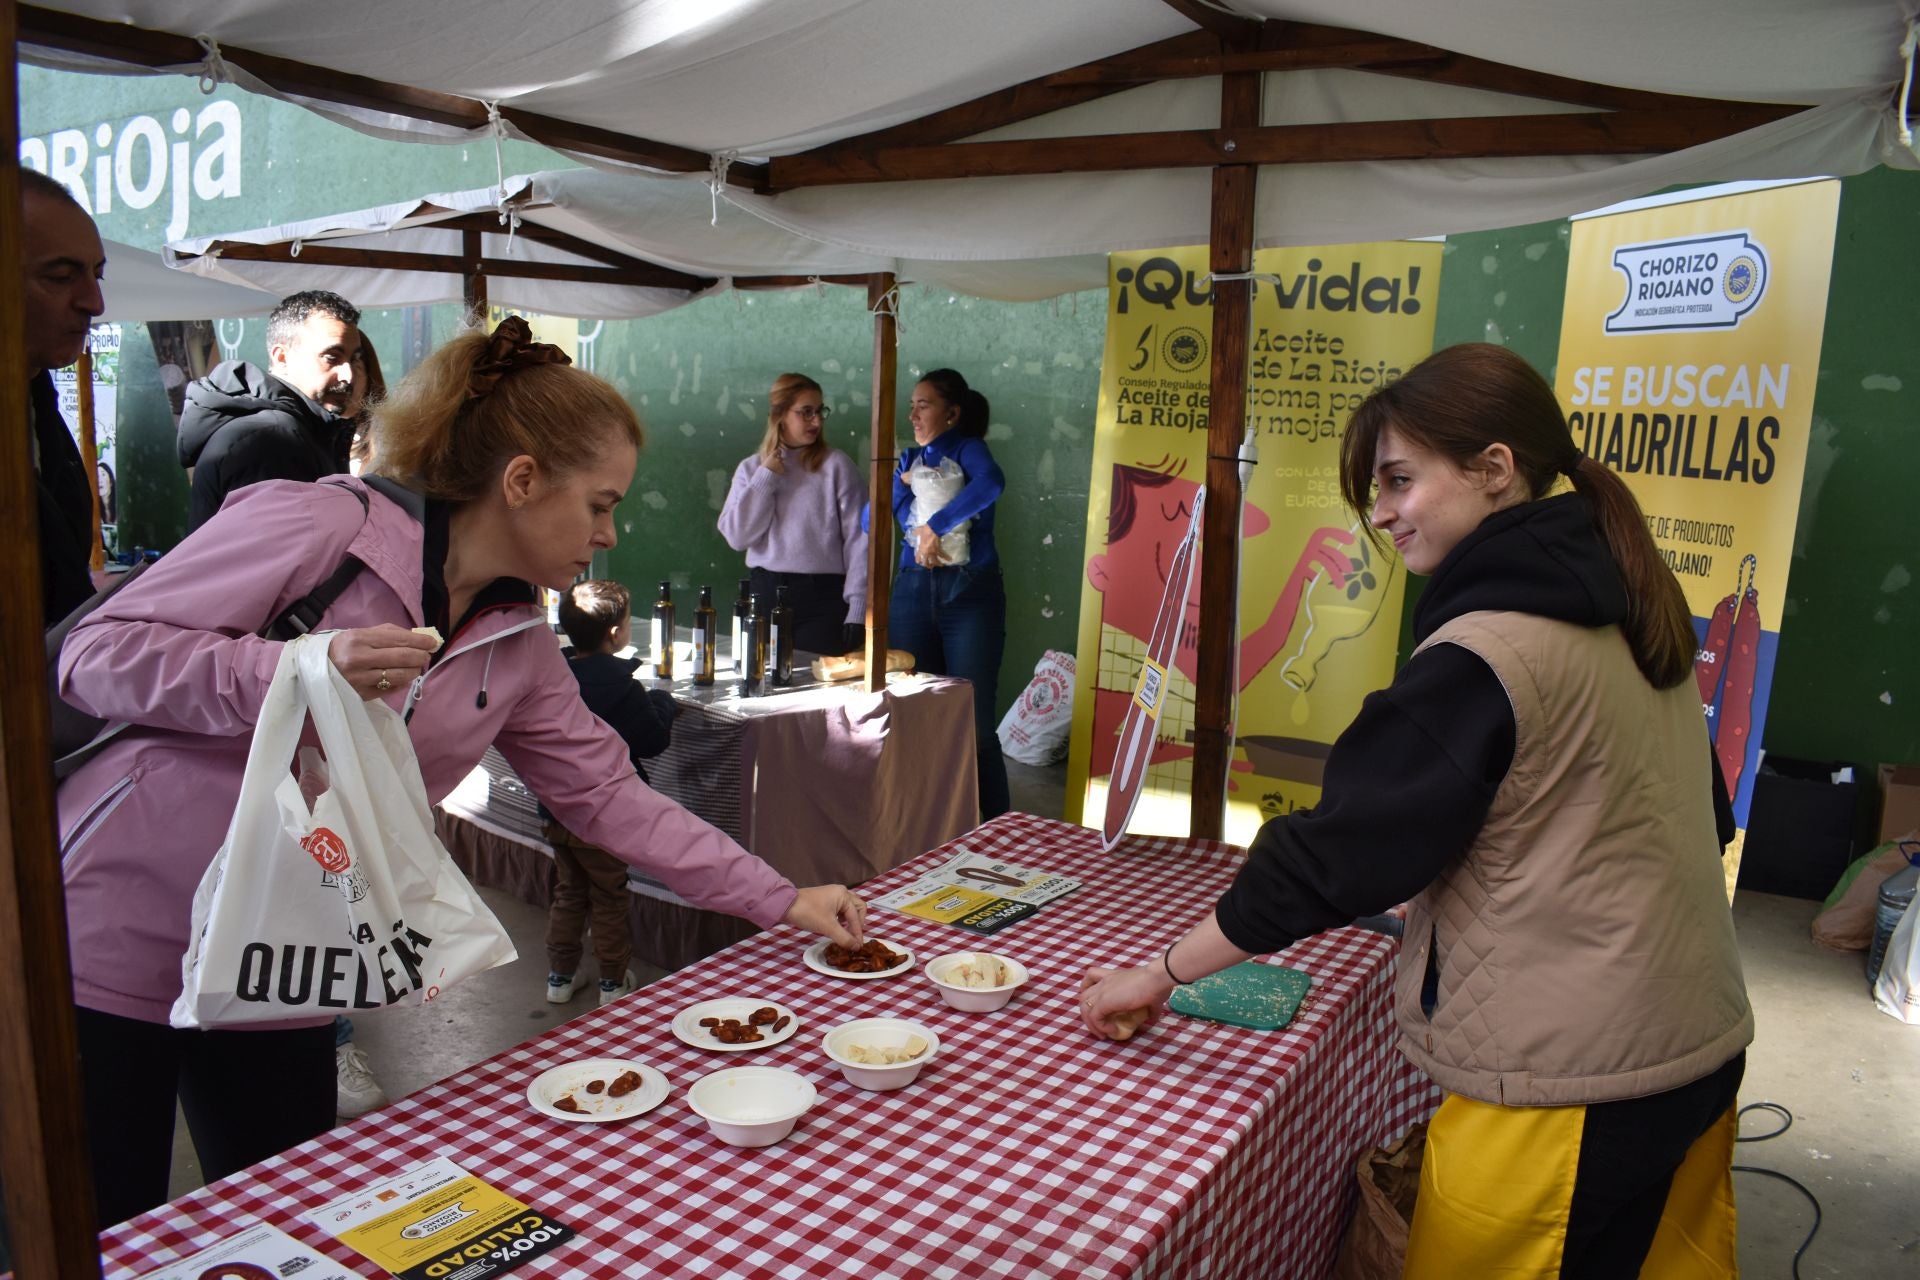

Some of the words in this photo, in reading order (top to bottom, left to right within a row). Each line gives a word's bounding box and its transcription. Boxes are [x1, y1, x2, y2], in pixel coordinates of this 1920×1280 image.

[1640, 252, 1718, 278] CHORIZO
[1271, 258, 1421, 315] vida!
[1638, 276, 1714, 300] RIOJANO
[1253, 328, 1344, 355] Aceite
[1118, 376, 1157, 389] Consejo
[1250, 356, 1282, 379] de
[1289, 357, 1321, 381] La
[1329, 359, 1402, 390] Rioja
[1117, 387, 1180, 407] Aceite
[1186, 392, 1210, 408] de
[1247, 385, 1321, 409] toma
[1571, 366, 1614, 406] SE
[1621, 363, 1790, 410] BUSCAN
[1116, 405, 1143, 425] La
[1149, 407, 1209, 433] Rioja
[1269, 413, 1345, 443] moja.
[1568, 411, 1780, 485] CUADRILLAS
[1275, 467, 1303, 478] CON
[1305, 467, 1320, 478] LA
[1307, 479, 1327, 492] DE
[1286, 494, 1344, 509] EUROP
[1656, 516, 1672, 539] DE
[1672, 518, 1735, 548] PRODUCTOS
[963, 901, 1016, 925] CALIDAD
[426, 1213, 464, 1232] CHORIZO
[428, 1210, 460, 1227] RIOJANO
[425, 1216, 544, 1277] CALIDAD
[491, 1224, 563, 1263] 100%
